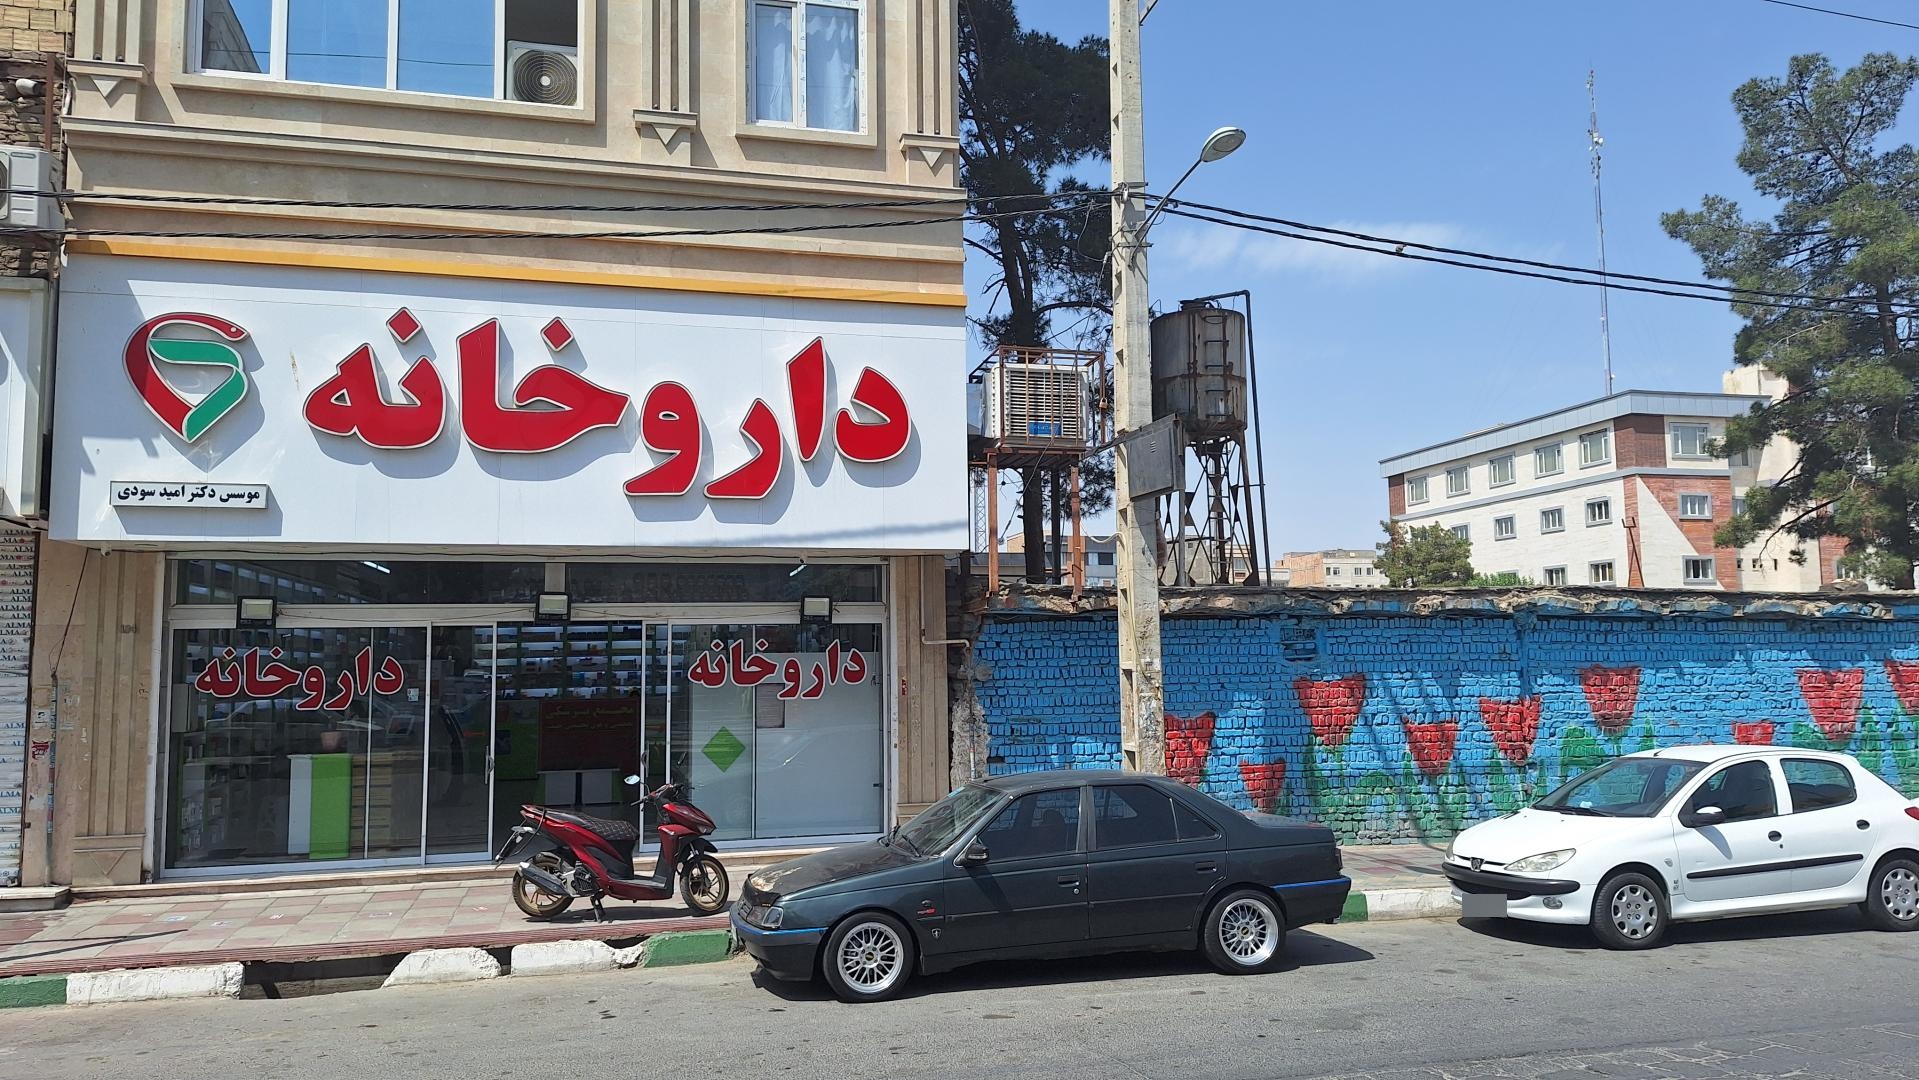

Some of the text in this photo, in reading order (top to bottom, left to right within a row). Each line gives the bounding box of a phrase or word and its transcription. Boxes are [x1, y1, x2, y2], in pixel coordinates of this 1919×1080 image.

[302, 306, 911, 498] داروخانه
[117, 485, 260, 503] موسس دکتر امید سودی
[194, 644, 404, 711] داروخانه
[688, 638, 867, 699] داروخانه
